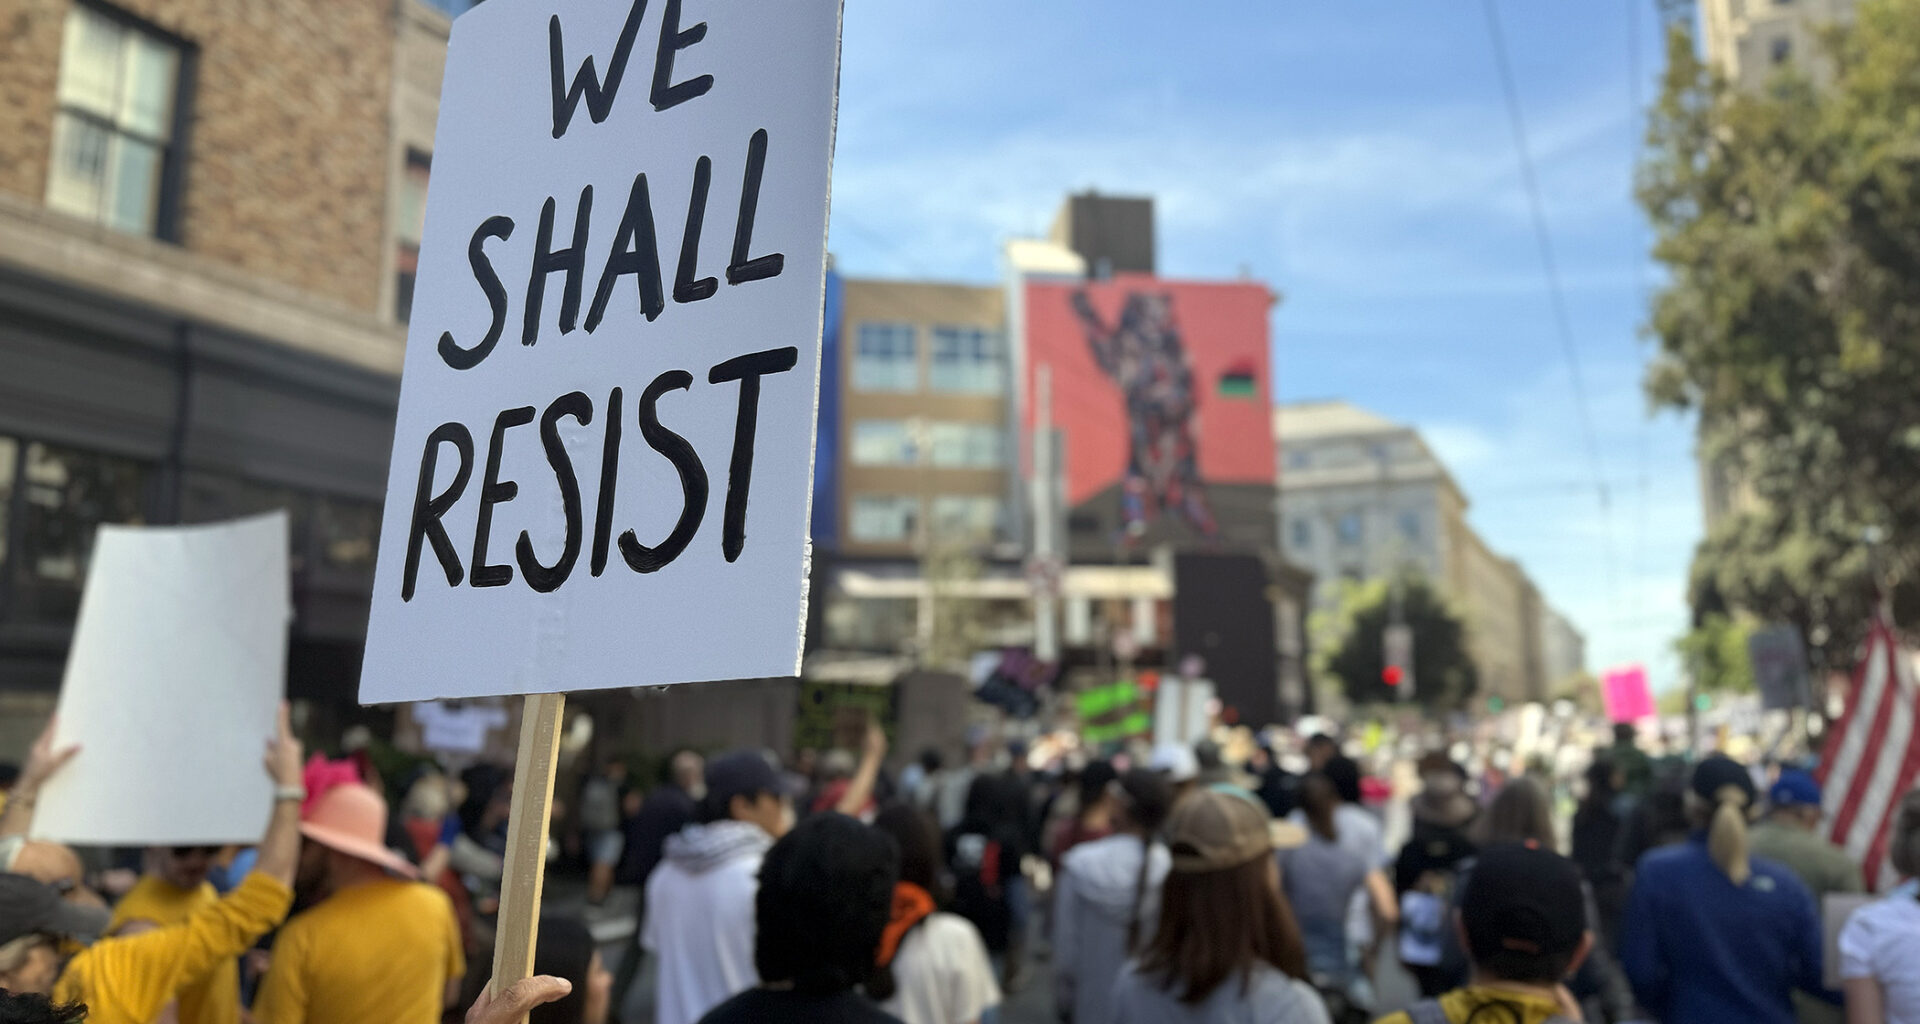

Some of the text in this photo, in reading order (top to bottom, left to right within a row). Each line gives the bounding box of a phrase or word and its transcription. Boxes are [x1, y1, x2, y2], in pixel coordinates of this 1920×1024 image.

[549, 0, 715, 140] WE
[437, 128, 785, 371] SHALL
[401, 346, 799, 603] RESIST
